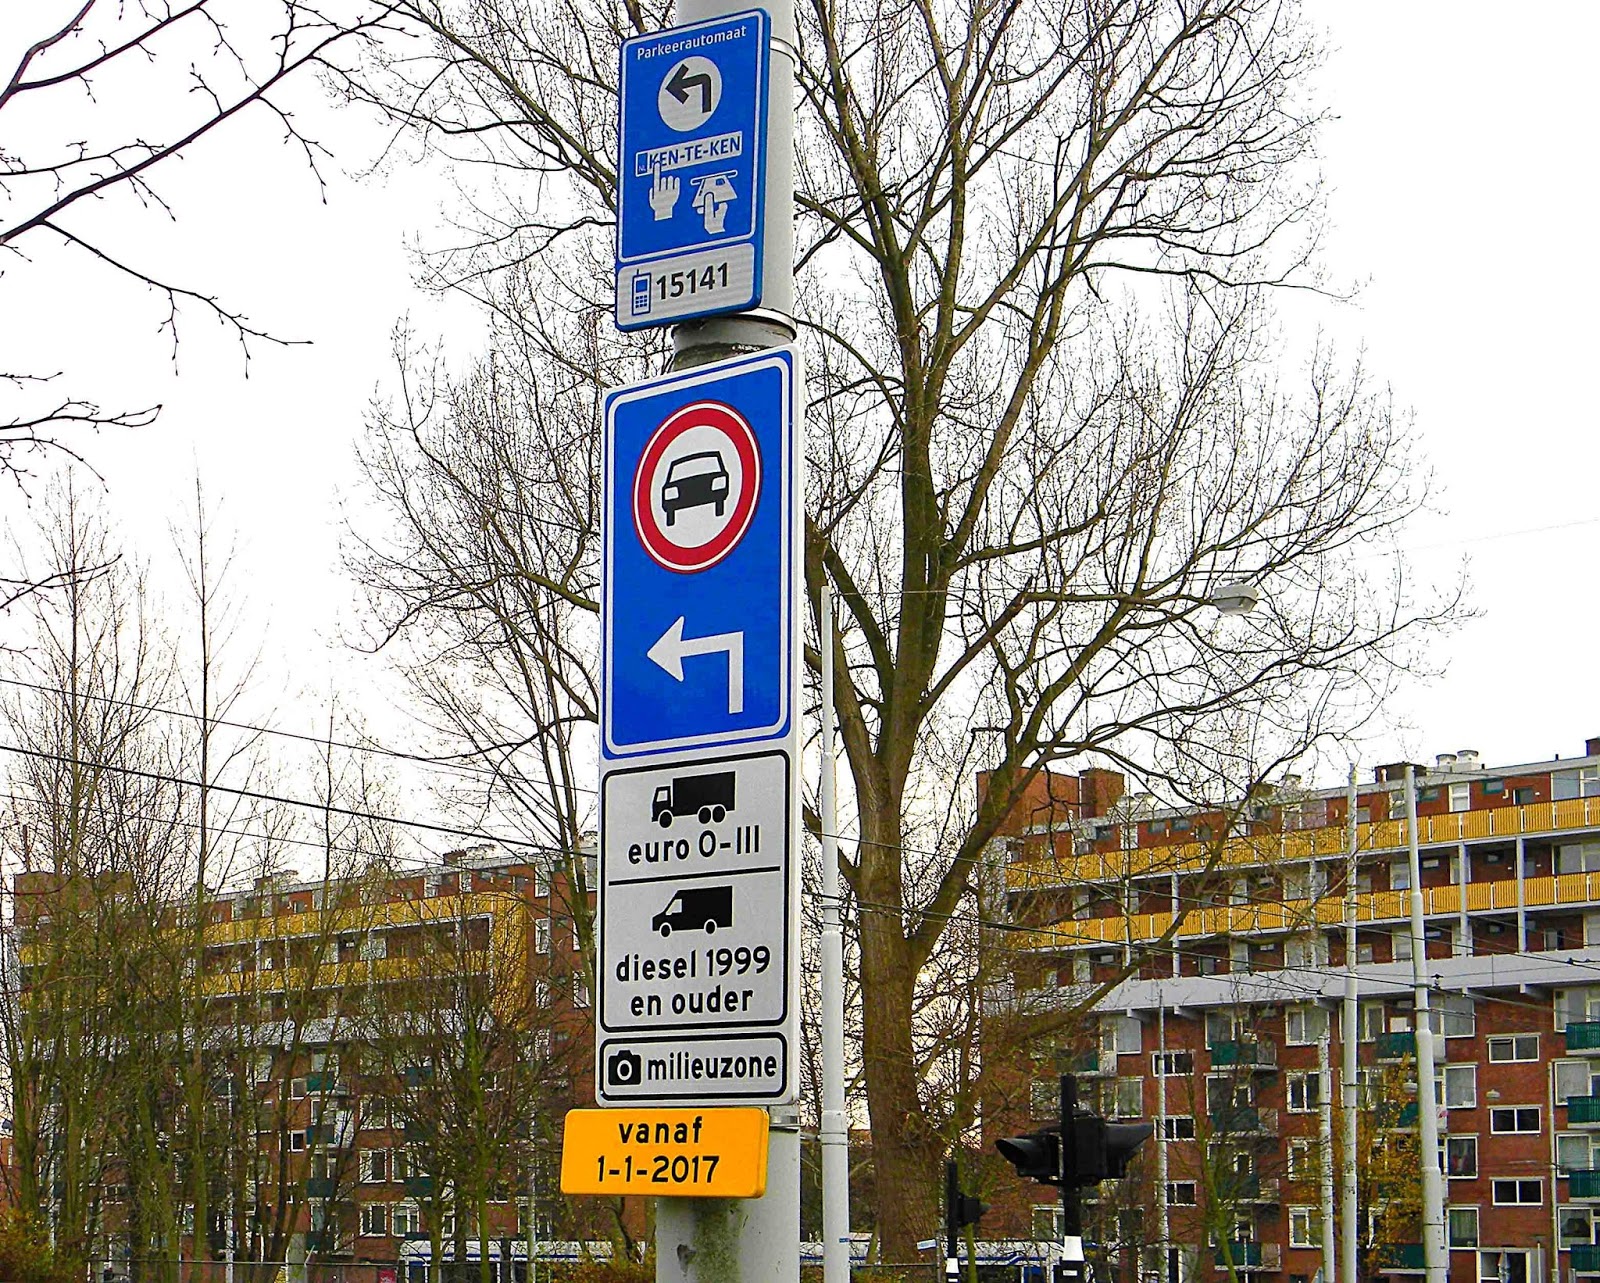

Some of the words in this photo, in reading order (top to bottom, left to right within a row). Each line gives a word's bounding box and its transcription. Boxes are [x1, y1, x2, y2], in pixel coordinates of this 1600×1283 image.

[636, 24, 747, 60] Parkeerautomaat
[649, 135, 741, 171] KEN-TE-KEN
[655, 262, 729, 300] 15141
[628, 838, 690, 865] euro
[616, 949, 697, 982] diesel
[705, 945, 771, 977] 1999
[630, 994, 662, 1017] en
[671, 984, 754, 1015] ouder
[647, 1051, 777, 1081] milieuzone
[618, 1115, 703, 1144] vanaf
[597, 1155, 720, 1184] 1-1-2017
